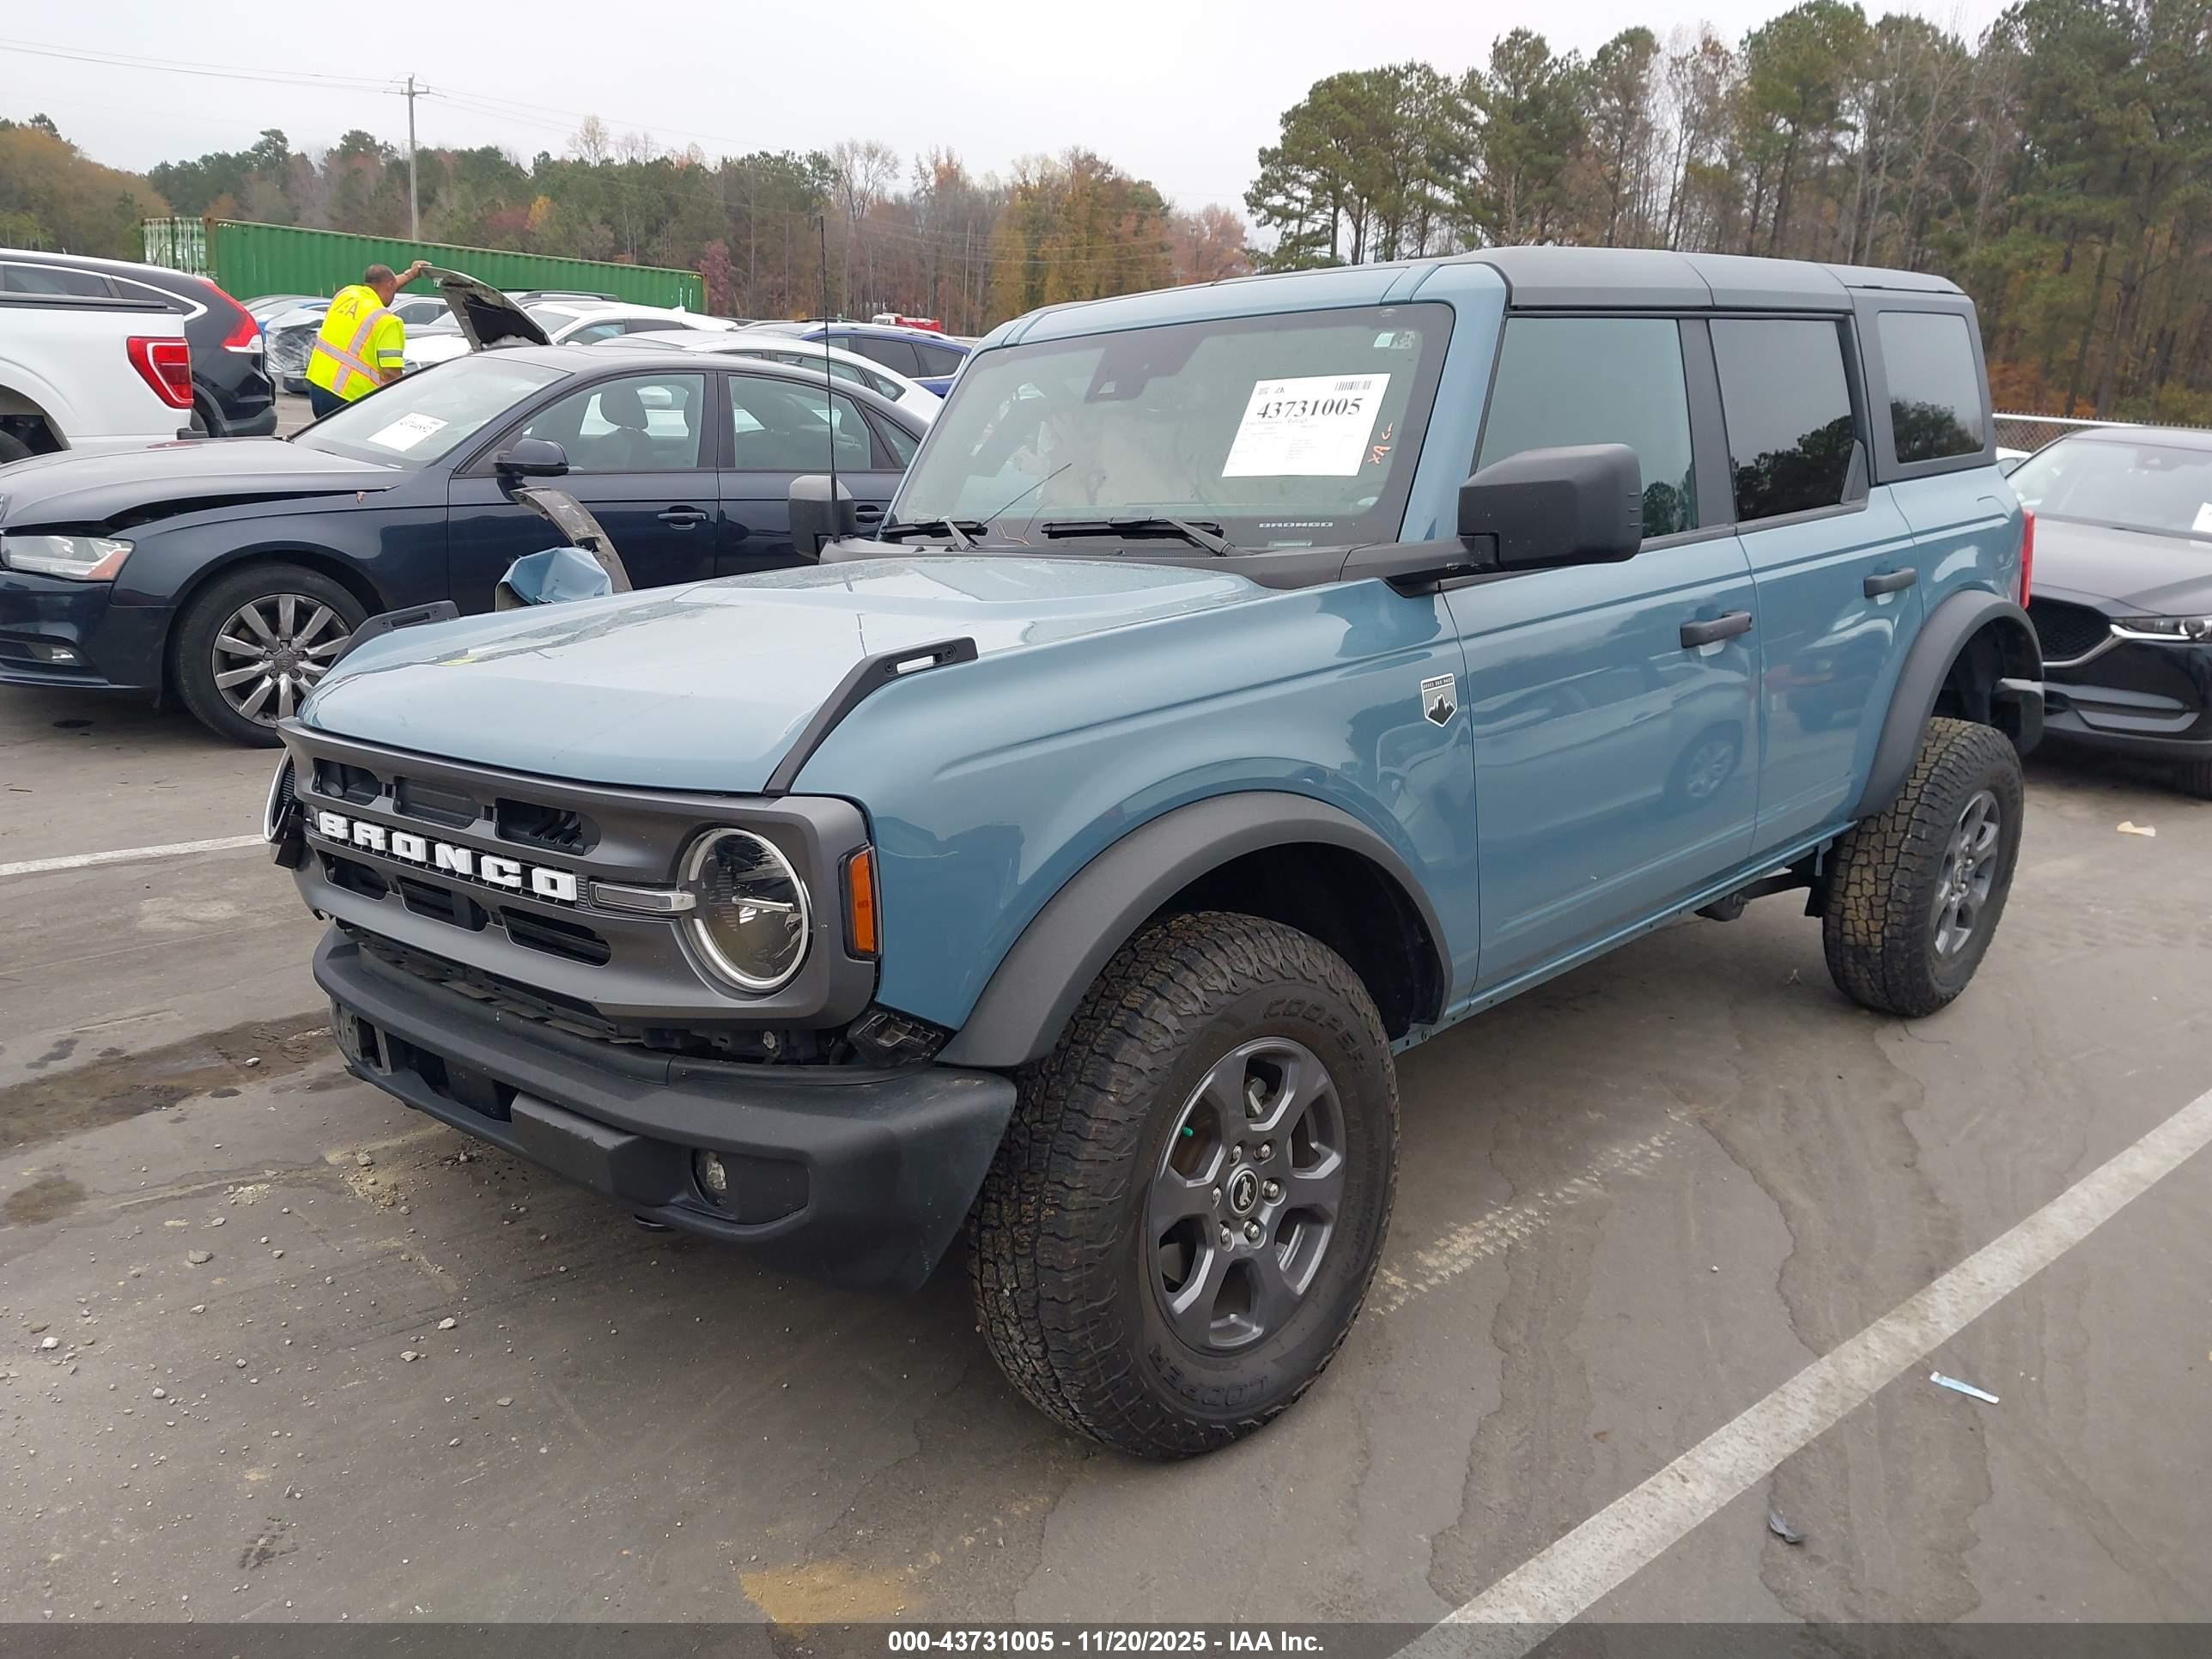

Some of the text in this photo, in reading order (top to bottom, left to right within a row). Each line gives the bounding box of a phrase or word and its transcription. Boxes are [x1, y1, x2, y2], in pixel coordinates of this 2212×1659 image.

[1257, 398, 1363, 418] 43731005
[319, 811, 579, 902] BRONCO
[1263, 997, 1367, 1073] COOPER
